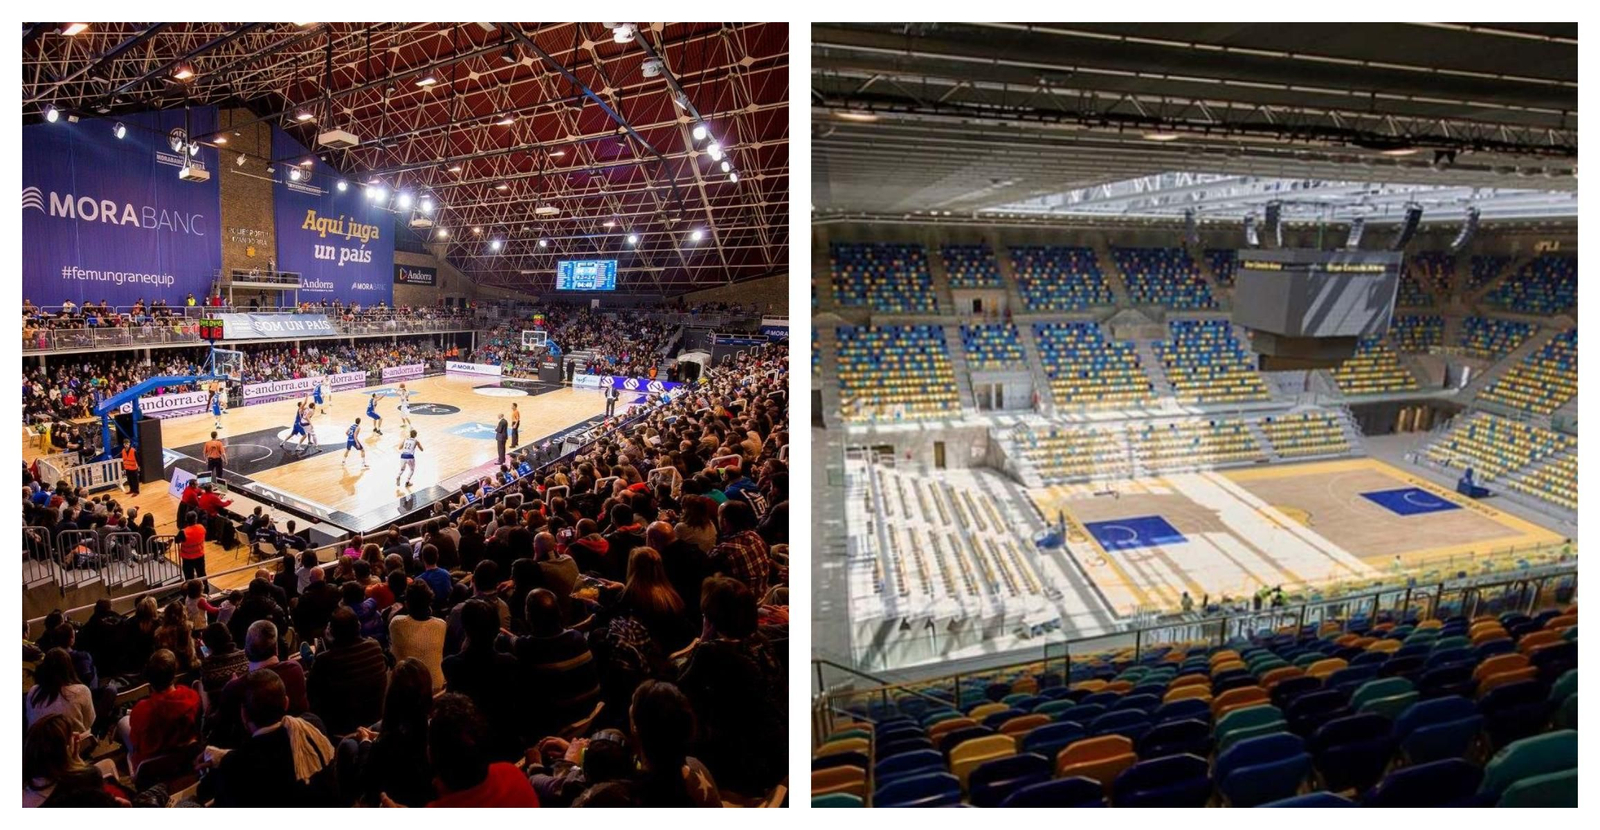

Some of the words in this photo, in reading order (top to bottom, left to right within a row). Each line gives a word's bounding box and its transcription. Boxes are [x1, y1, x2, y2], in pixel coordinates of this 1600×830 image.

[50, 191, 204, 236] MORABANC
[302, 209, 344, 238] Aquí
[346, 217, 379, 243] juga
[314, 244, 336, 260] un
[338, 244, 372, 267] país
[61, 265, 175, 288] #femungranequip
[302, 278, 334, 289] Andorra
[408, 269, 432, 280] Andorra
[255, 320, 282, 332] SOM
[285, 320, 303, 330] UN
[305, 318, 331, 330] PAÍS
[244, 380, 309, 396] e-andorra.eu
